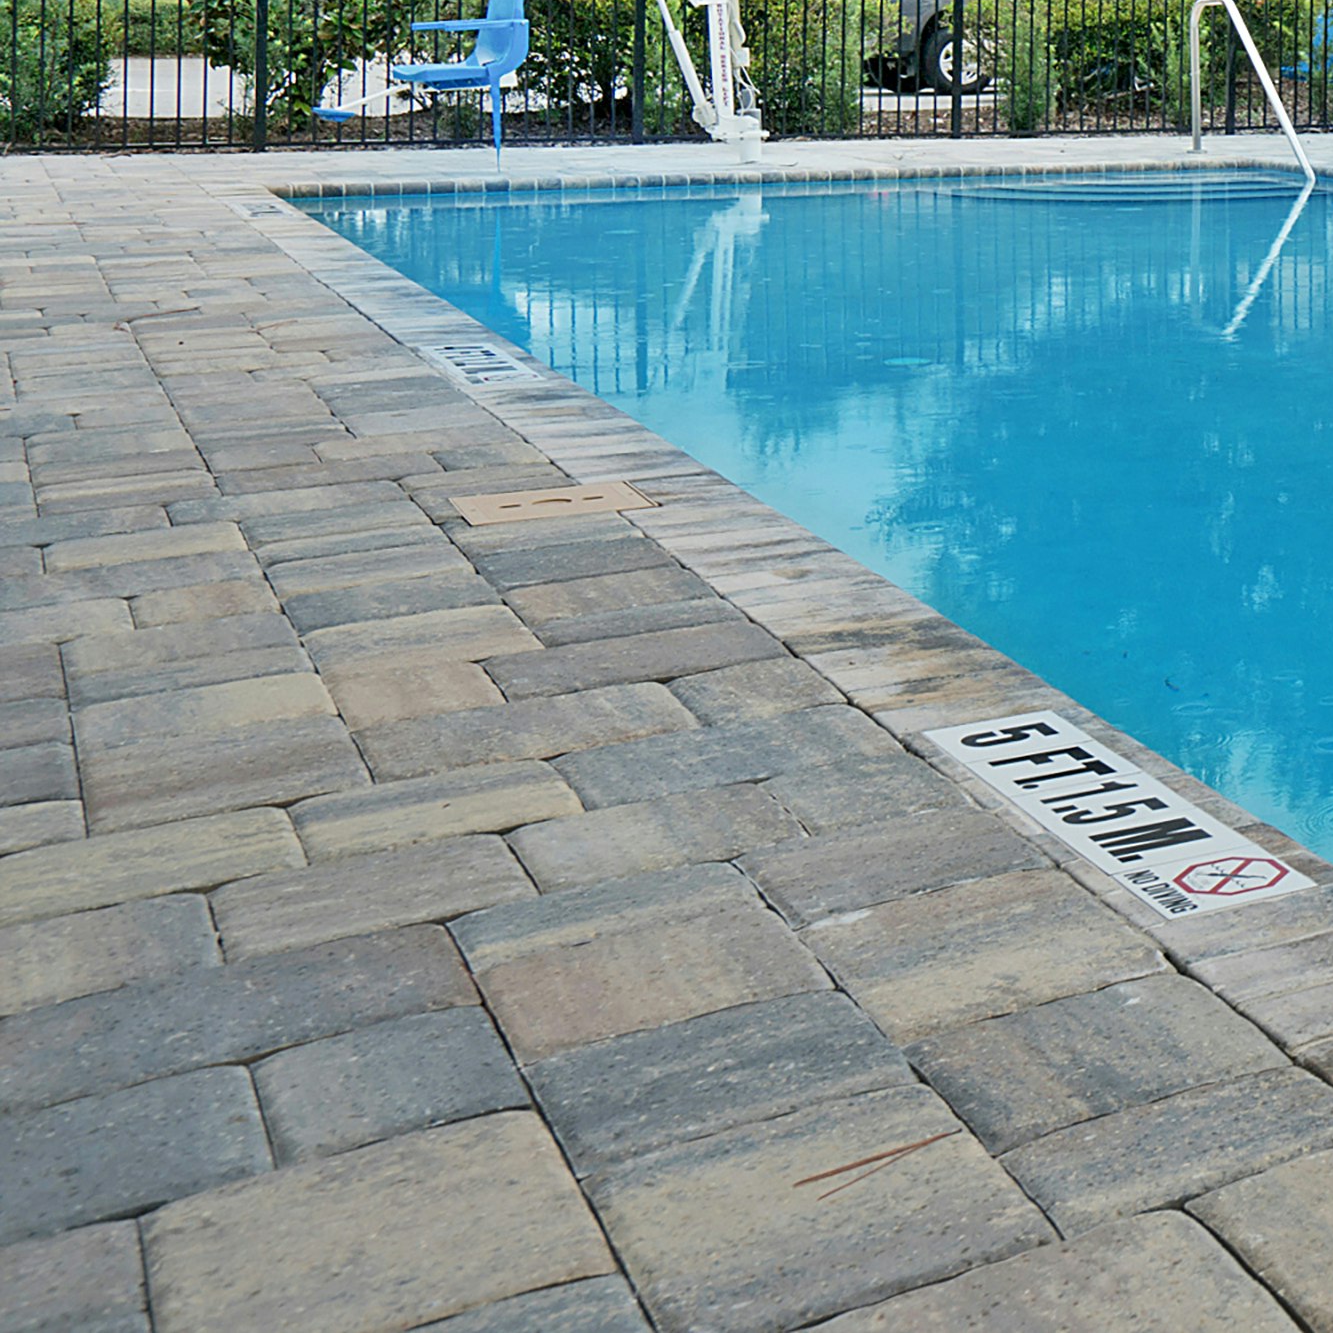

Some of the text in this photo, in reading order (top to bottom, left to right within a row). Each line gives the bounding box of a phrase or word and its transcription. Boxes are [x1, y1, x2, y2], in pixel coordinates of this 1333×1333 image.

[960, 721, 1213, 863] 5 FT. 1.5 M.
[1124, 869, 1198, 914] NO DIVING
